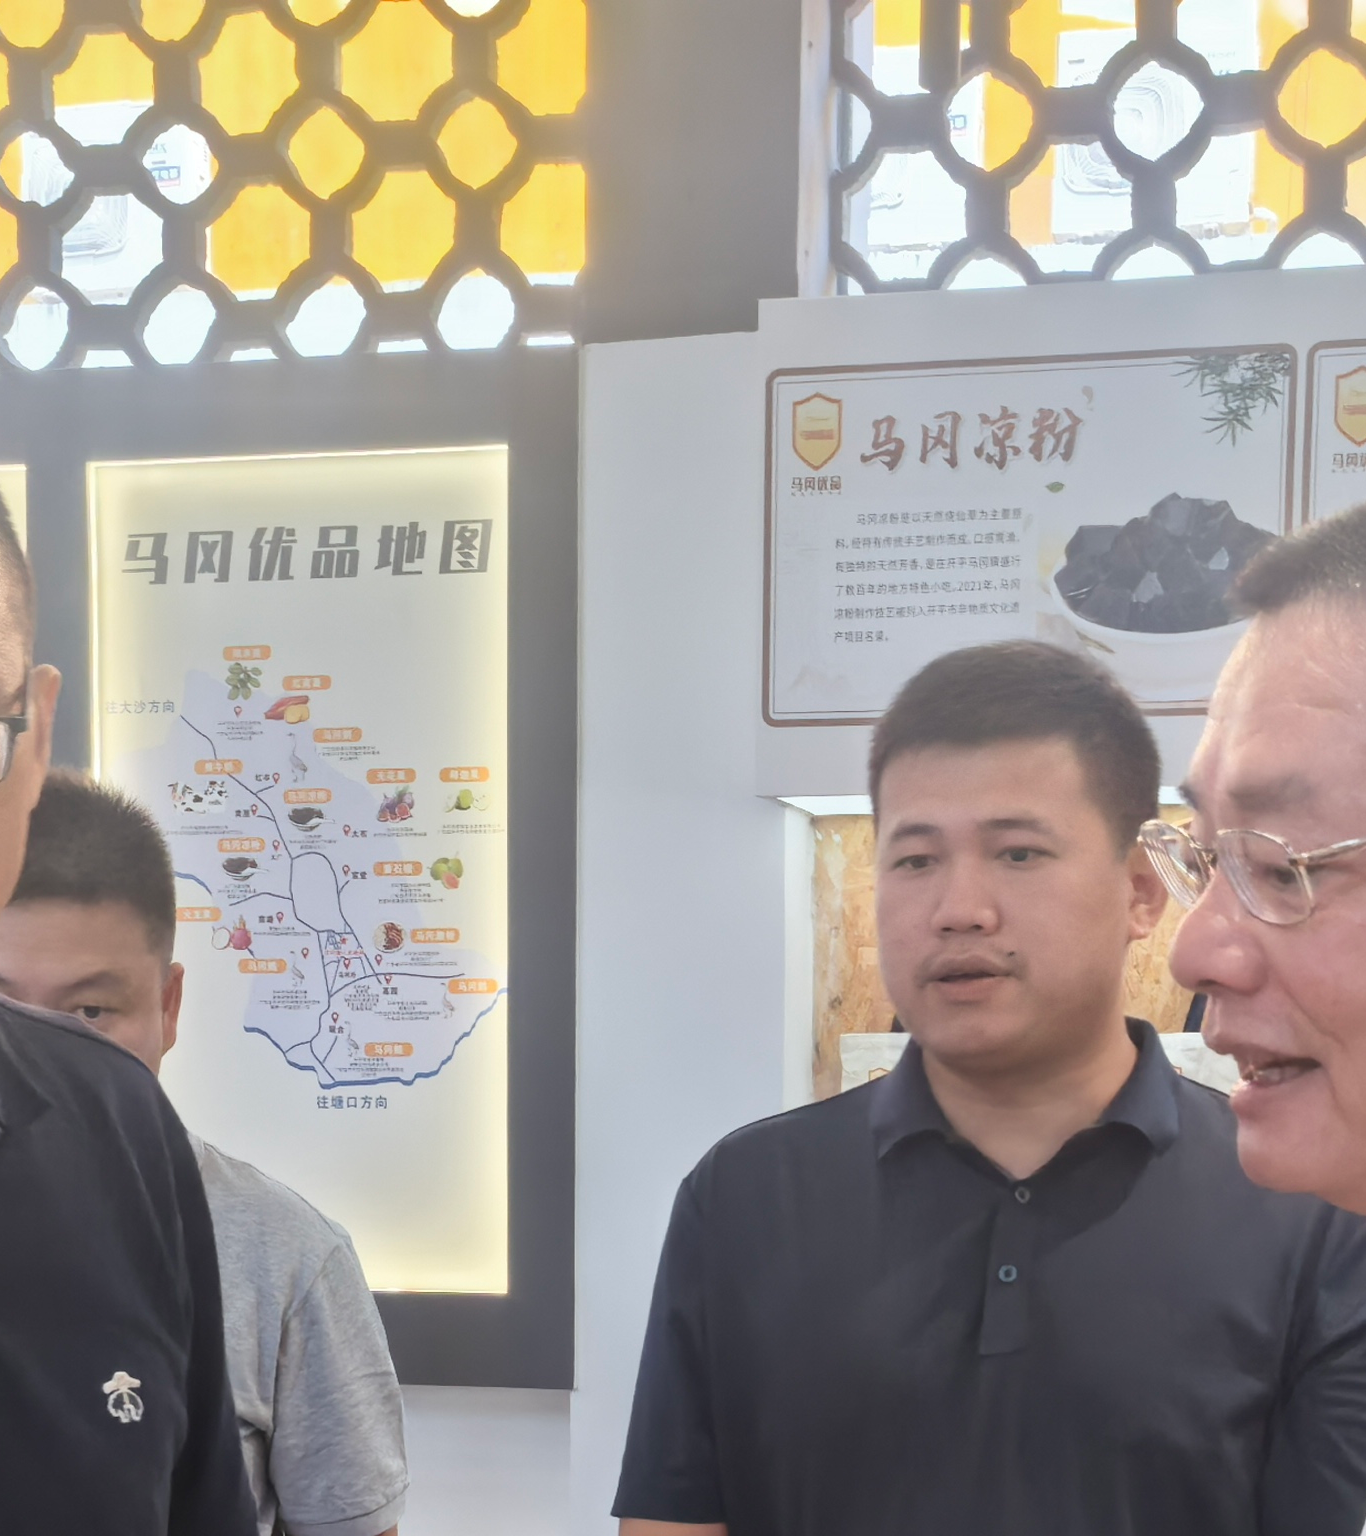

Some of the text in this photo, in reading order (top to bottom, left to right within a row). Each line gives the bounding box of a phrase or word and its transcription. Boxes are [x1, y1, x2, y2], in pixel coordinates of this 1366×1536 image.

[860, 405, 1083, 471] 马冈凉粉
[121, 519, 493, 585] 马冈优品地图
[106, 700, 175, 714] 往大沙方向
[316, 1095, 388, 1109] 往塘口方向
